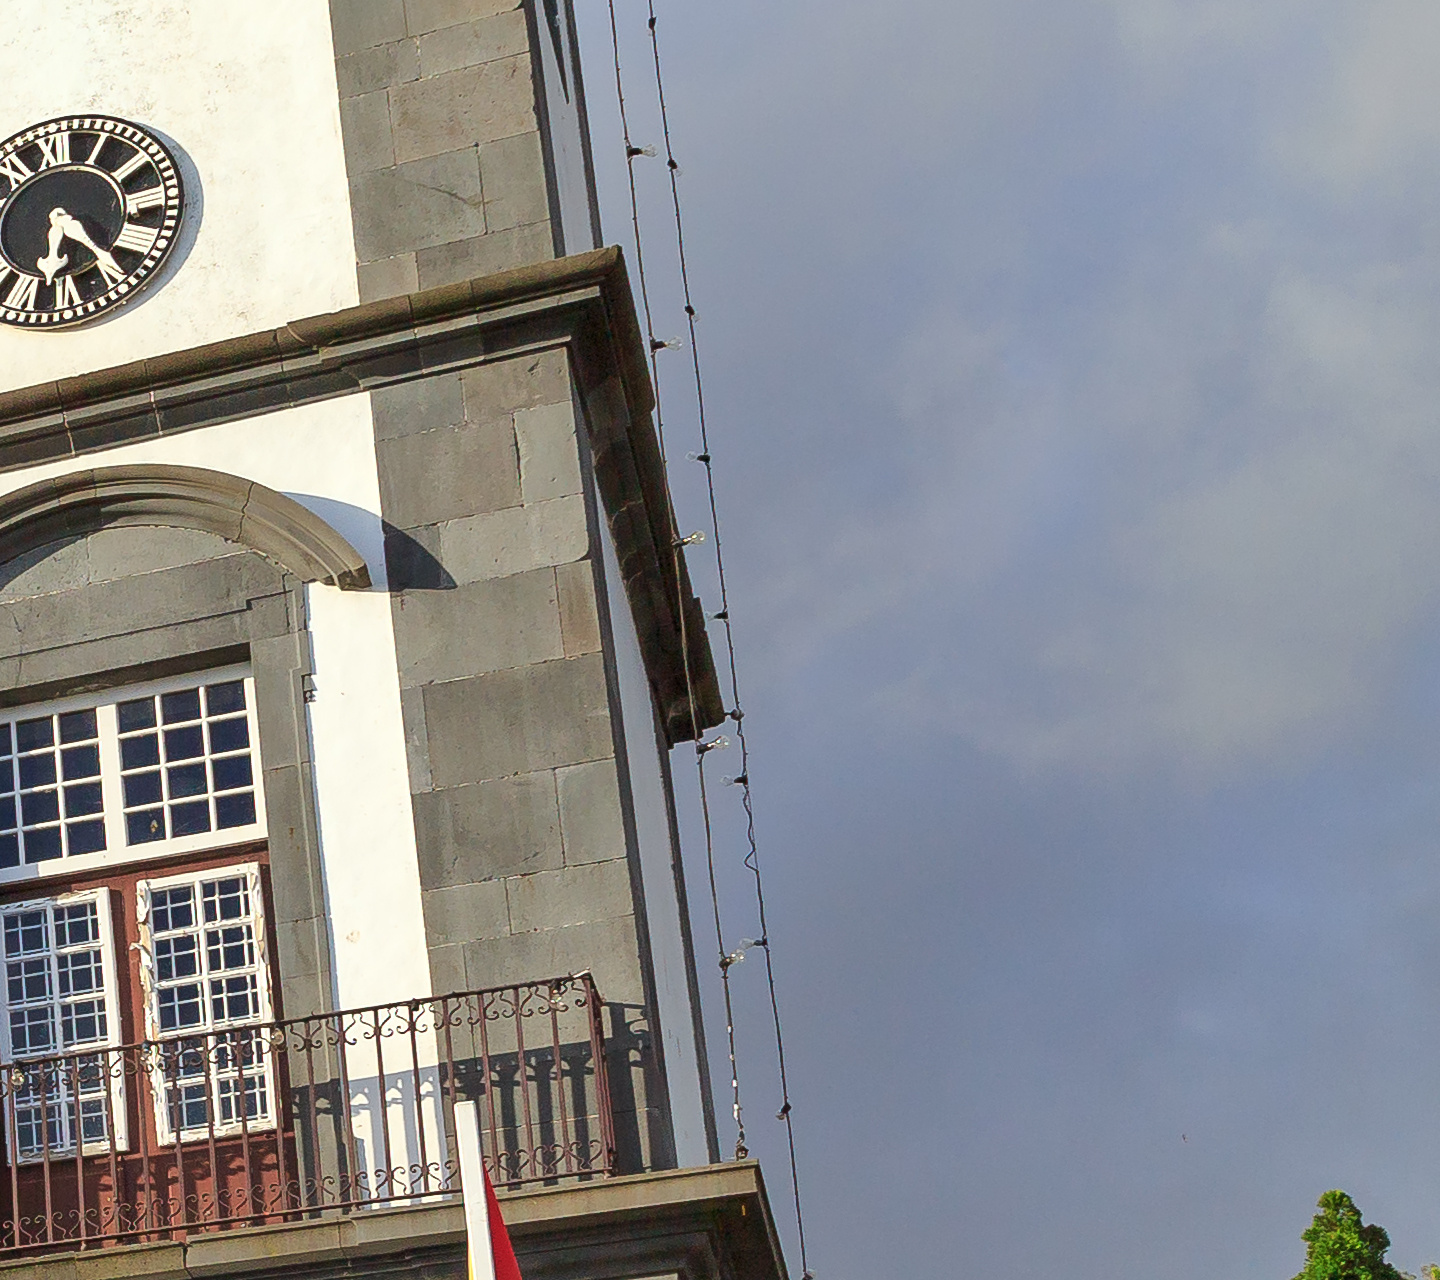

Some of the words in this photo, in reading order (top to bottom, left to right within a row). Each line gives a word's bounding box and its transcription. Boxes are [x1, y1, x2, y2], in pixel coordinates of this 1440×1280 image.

[36, 132, 72, 171] XII
[85, 132, 109, 165] I
[111, 150, 151, 183] II
[54, 275, 84, 310] VI
